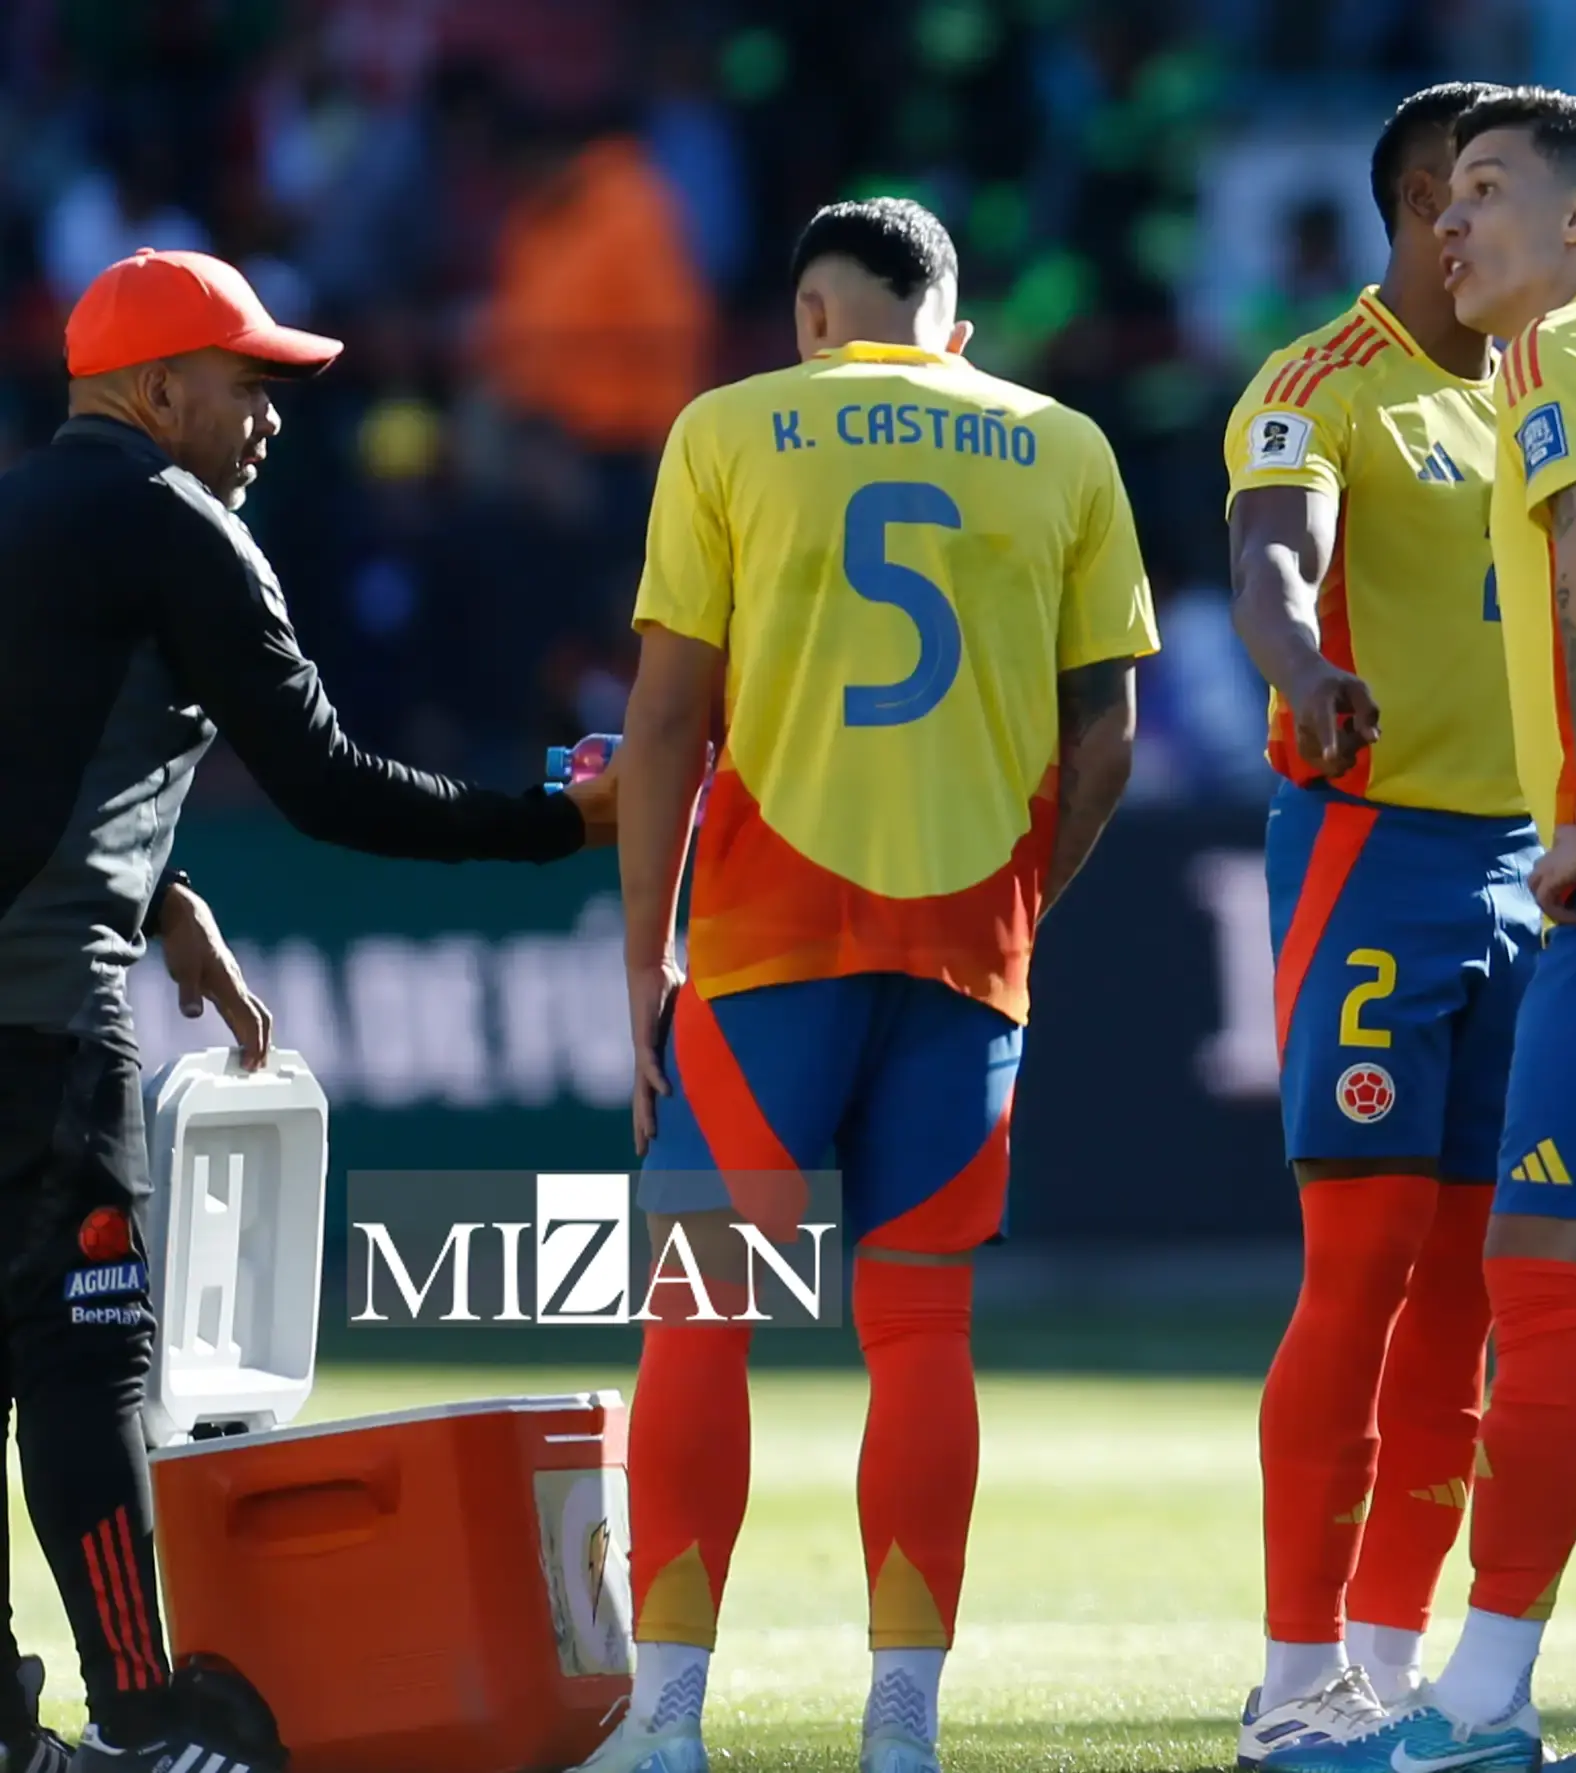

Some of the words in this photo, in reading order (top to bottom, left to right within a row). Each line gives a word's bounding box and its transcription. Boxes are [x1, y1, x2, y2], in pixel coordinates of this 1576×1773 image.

[773, 409, 816, 452] K.
[836, 403, 1037, 467] CASTAÑO
[843, 481, 961, 727] 5
[1339, 948, 1397, 1048] 2
[68, 1264, 140, 1298] AGUILA
